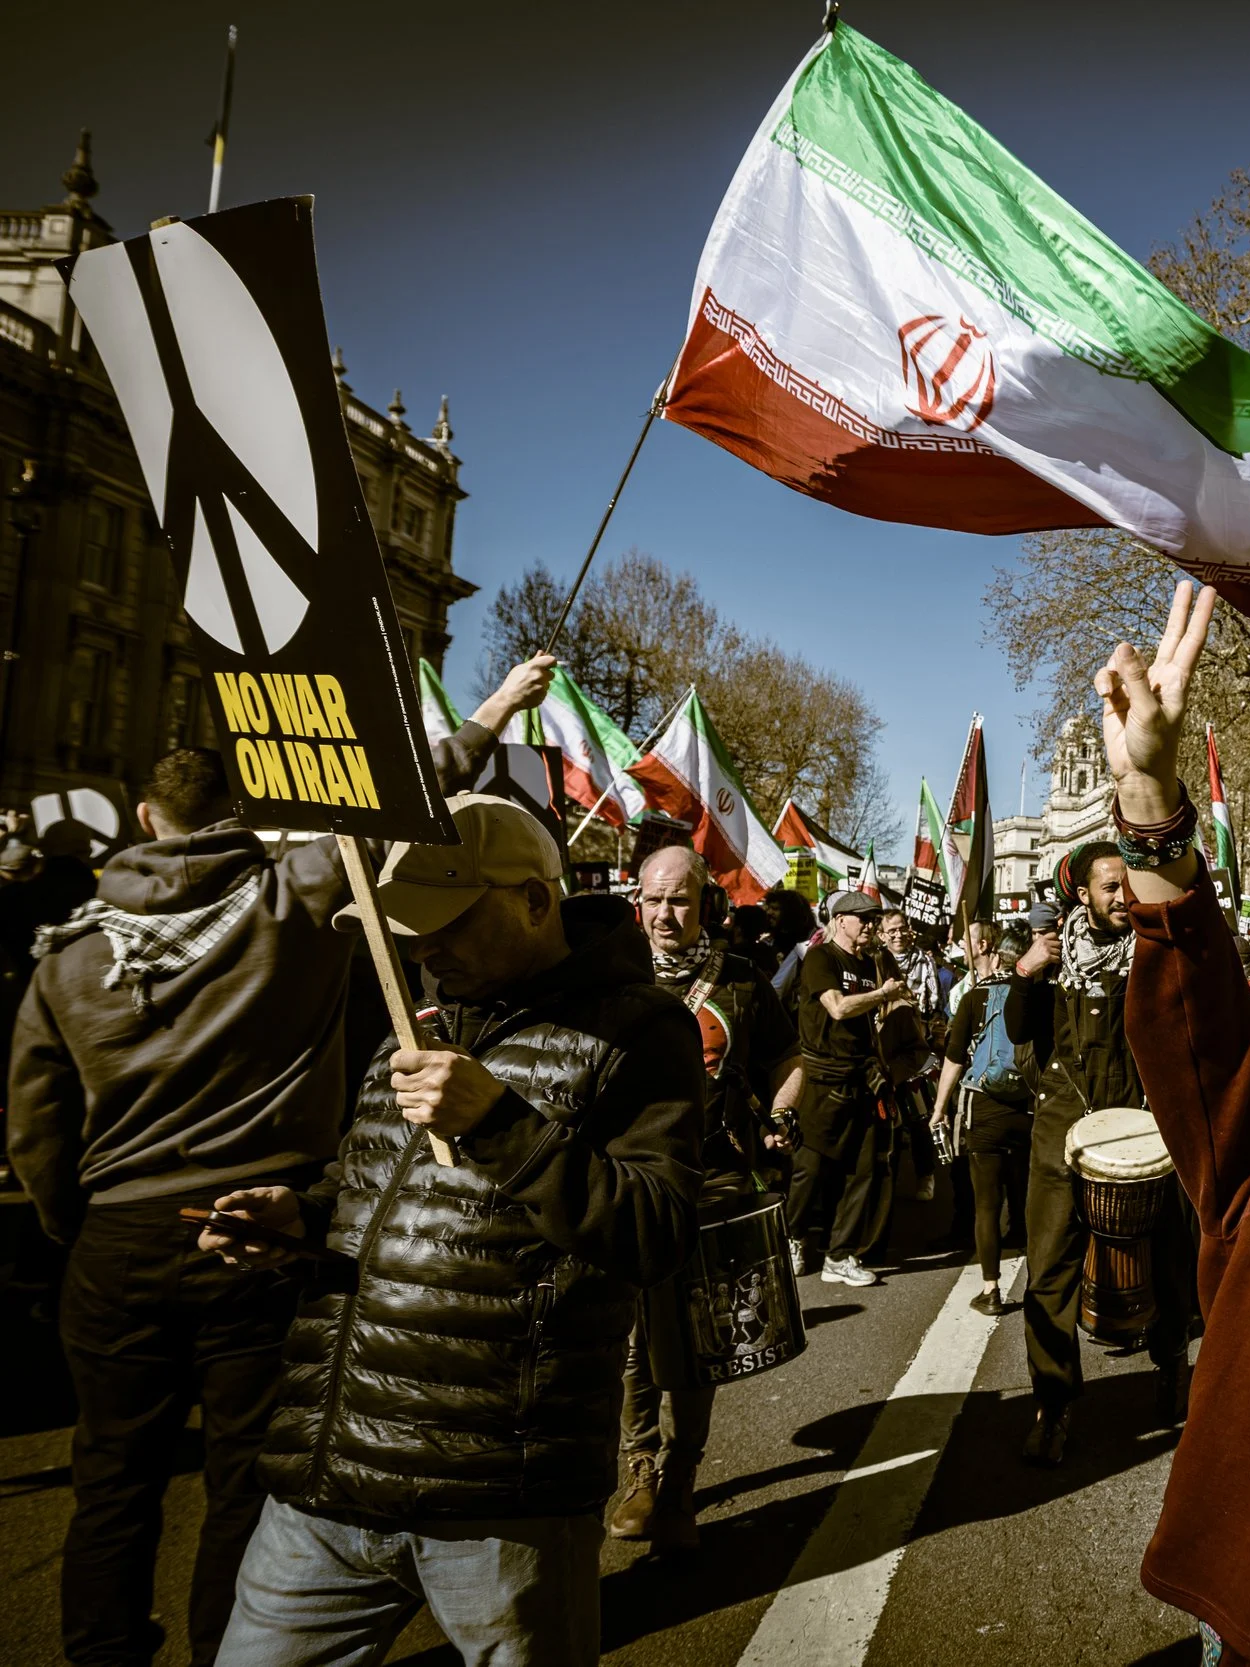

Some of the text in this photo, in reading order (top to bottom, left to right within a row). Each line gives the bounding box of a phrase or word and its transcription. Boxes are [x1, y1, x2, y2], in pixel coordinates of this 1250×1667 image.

[214, 672, 357, 740] NO WAR
[236, 737, 381, 810] ON IRAN
[910, 888, 939, 906] STOP
[999, 897, 1028, 912] Stop
[905, 905, 937, 925] WARS
[709, 1341, 788, 1381] RESIST
